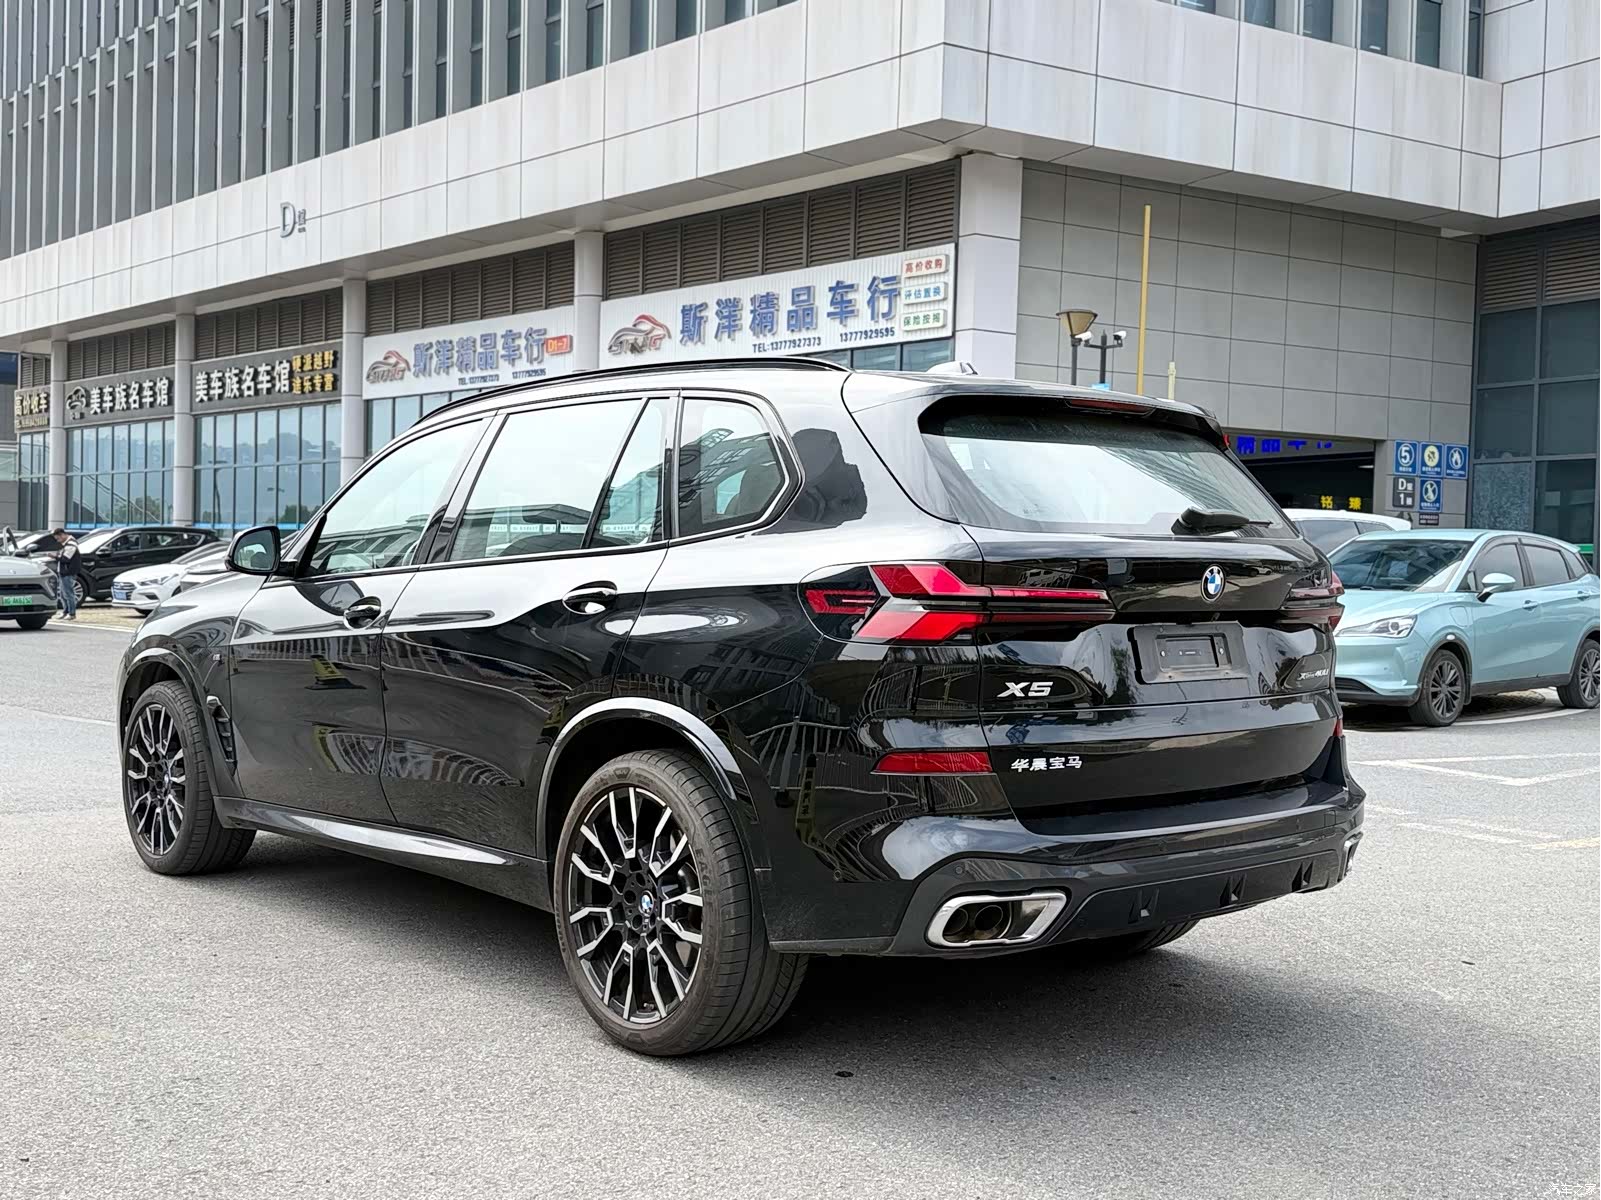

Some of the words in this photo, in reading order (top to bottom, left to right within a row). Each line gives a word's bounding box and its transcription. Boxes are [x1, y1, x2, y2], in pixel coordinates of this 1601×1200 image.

[905, 258, 943, 273] 高价收购
[904, 286, 941, 300] 评估置换
[678, 275, 901, 344] 斯洋精品车行
[412, 327, 547, 377] 斯洋精品车行
[195, 360, 290, 402] 美车族名车馆
[90, 376, 169, 414] 美车族名车馆
[996, 682, 1053, 698] X5
[1011, 756, 1083, 772] 华晨宝马
